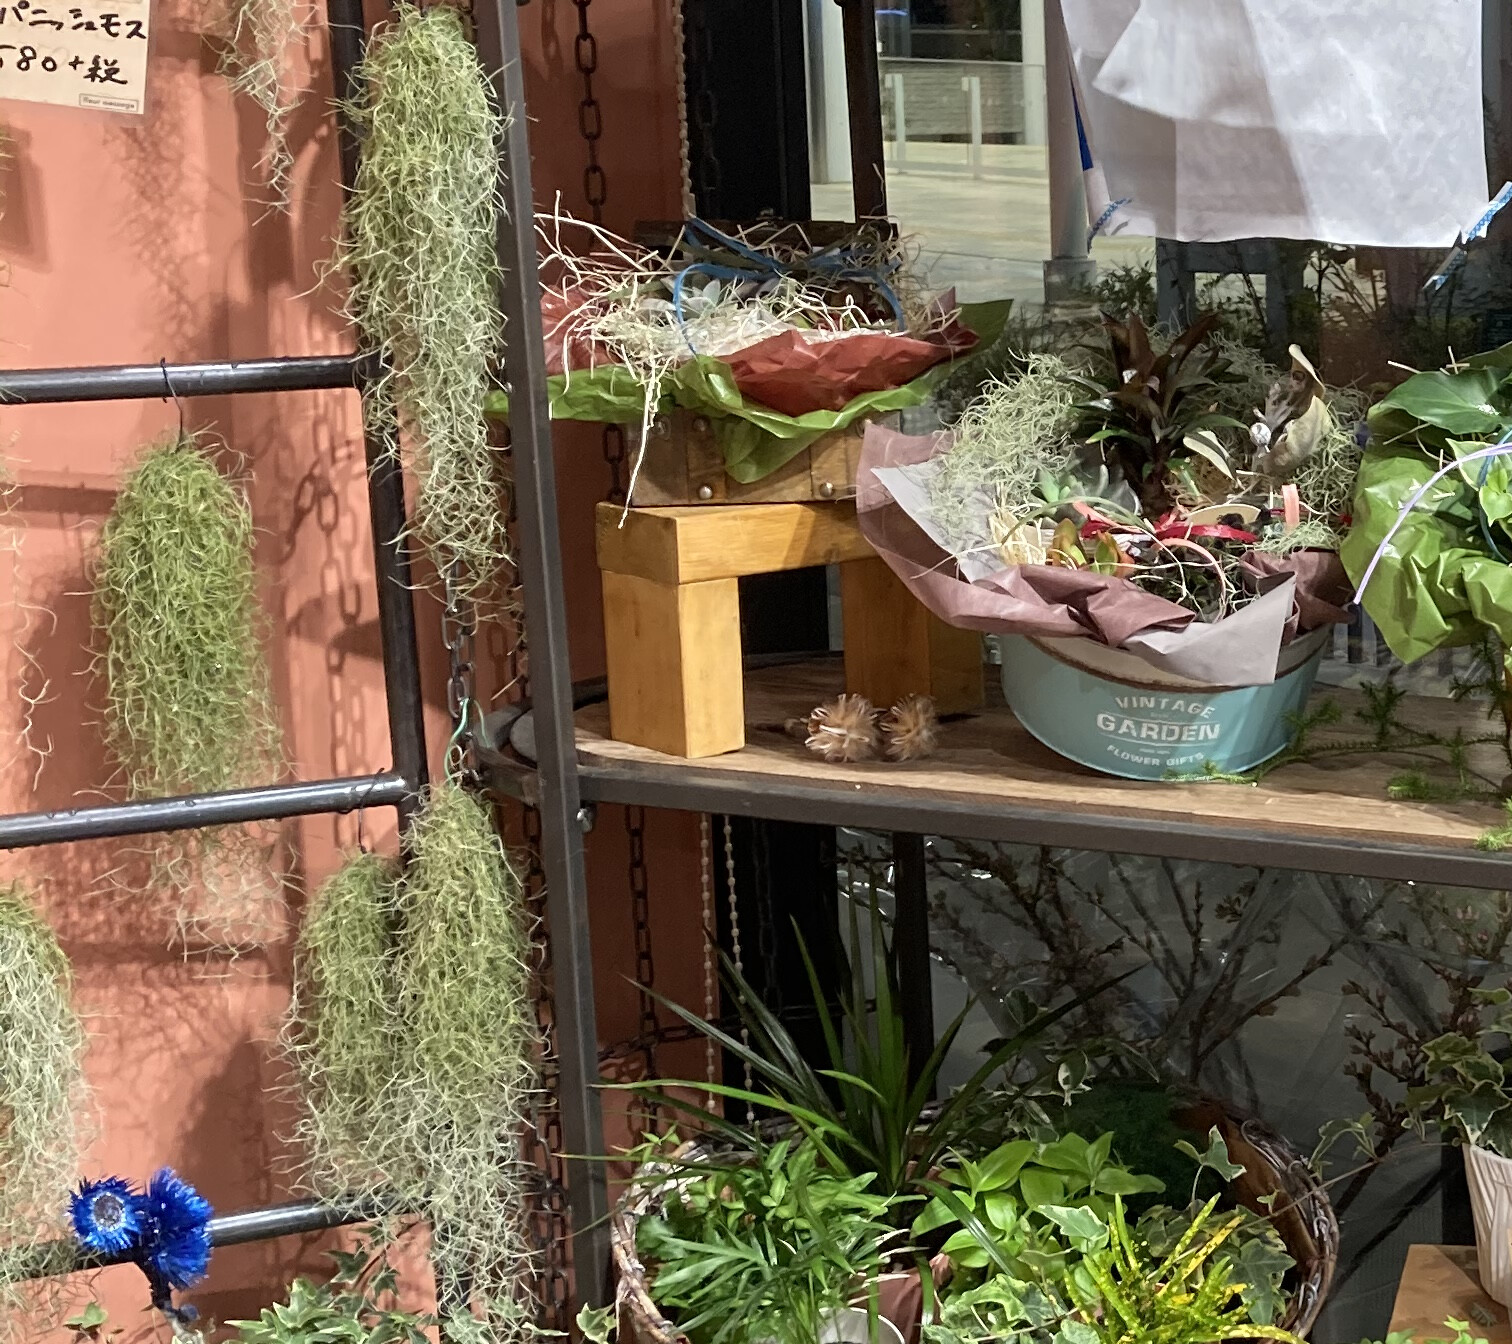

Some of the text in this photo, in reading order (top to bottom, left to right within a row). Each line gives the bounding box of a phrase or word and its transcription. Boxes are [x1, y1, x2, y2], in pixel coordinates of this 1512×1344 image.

[1115, 696, 1215, 718] VINTAGE
[1096, 713, 1221, 741] GARDEN
[1107, 745, 1204, 766] FLOWER GIFTS
